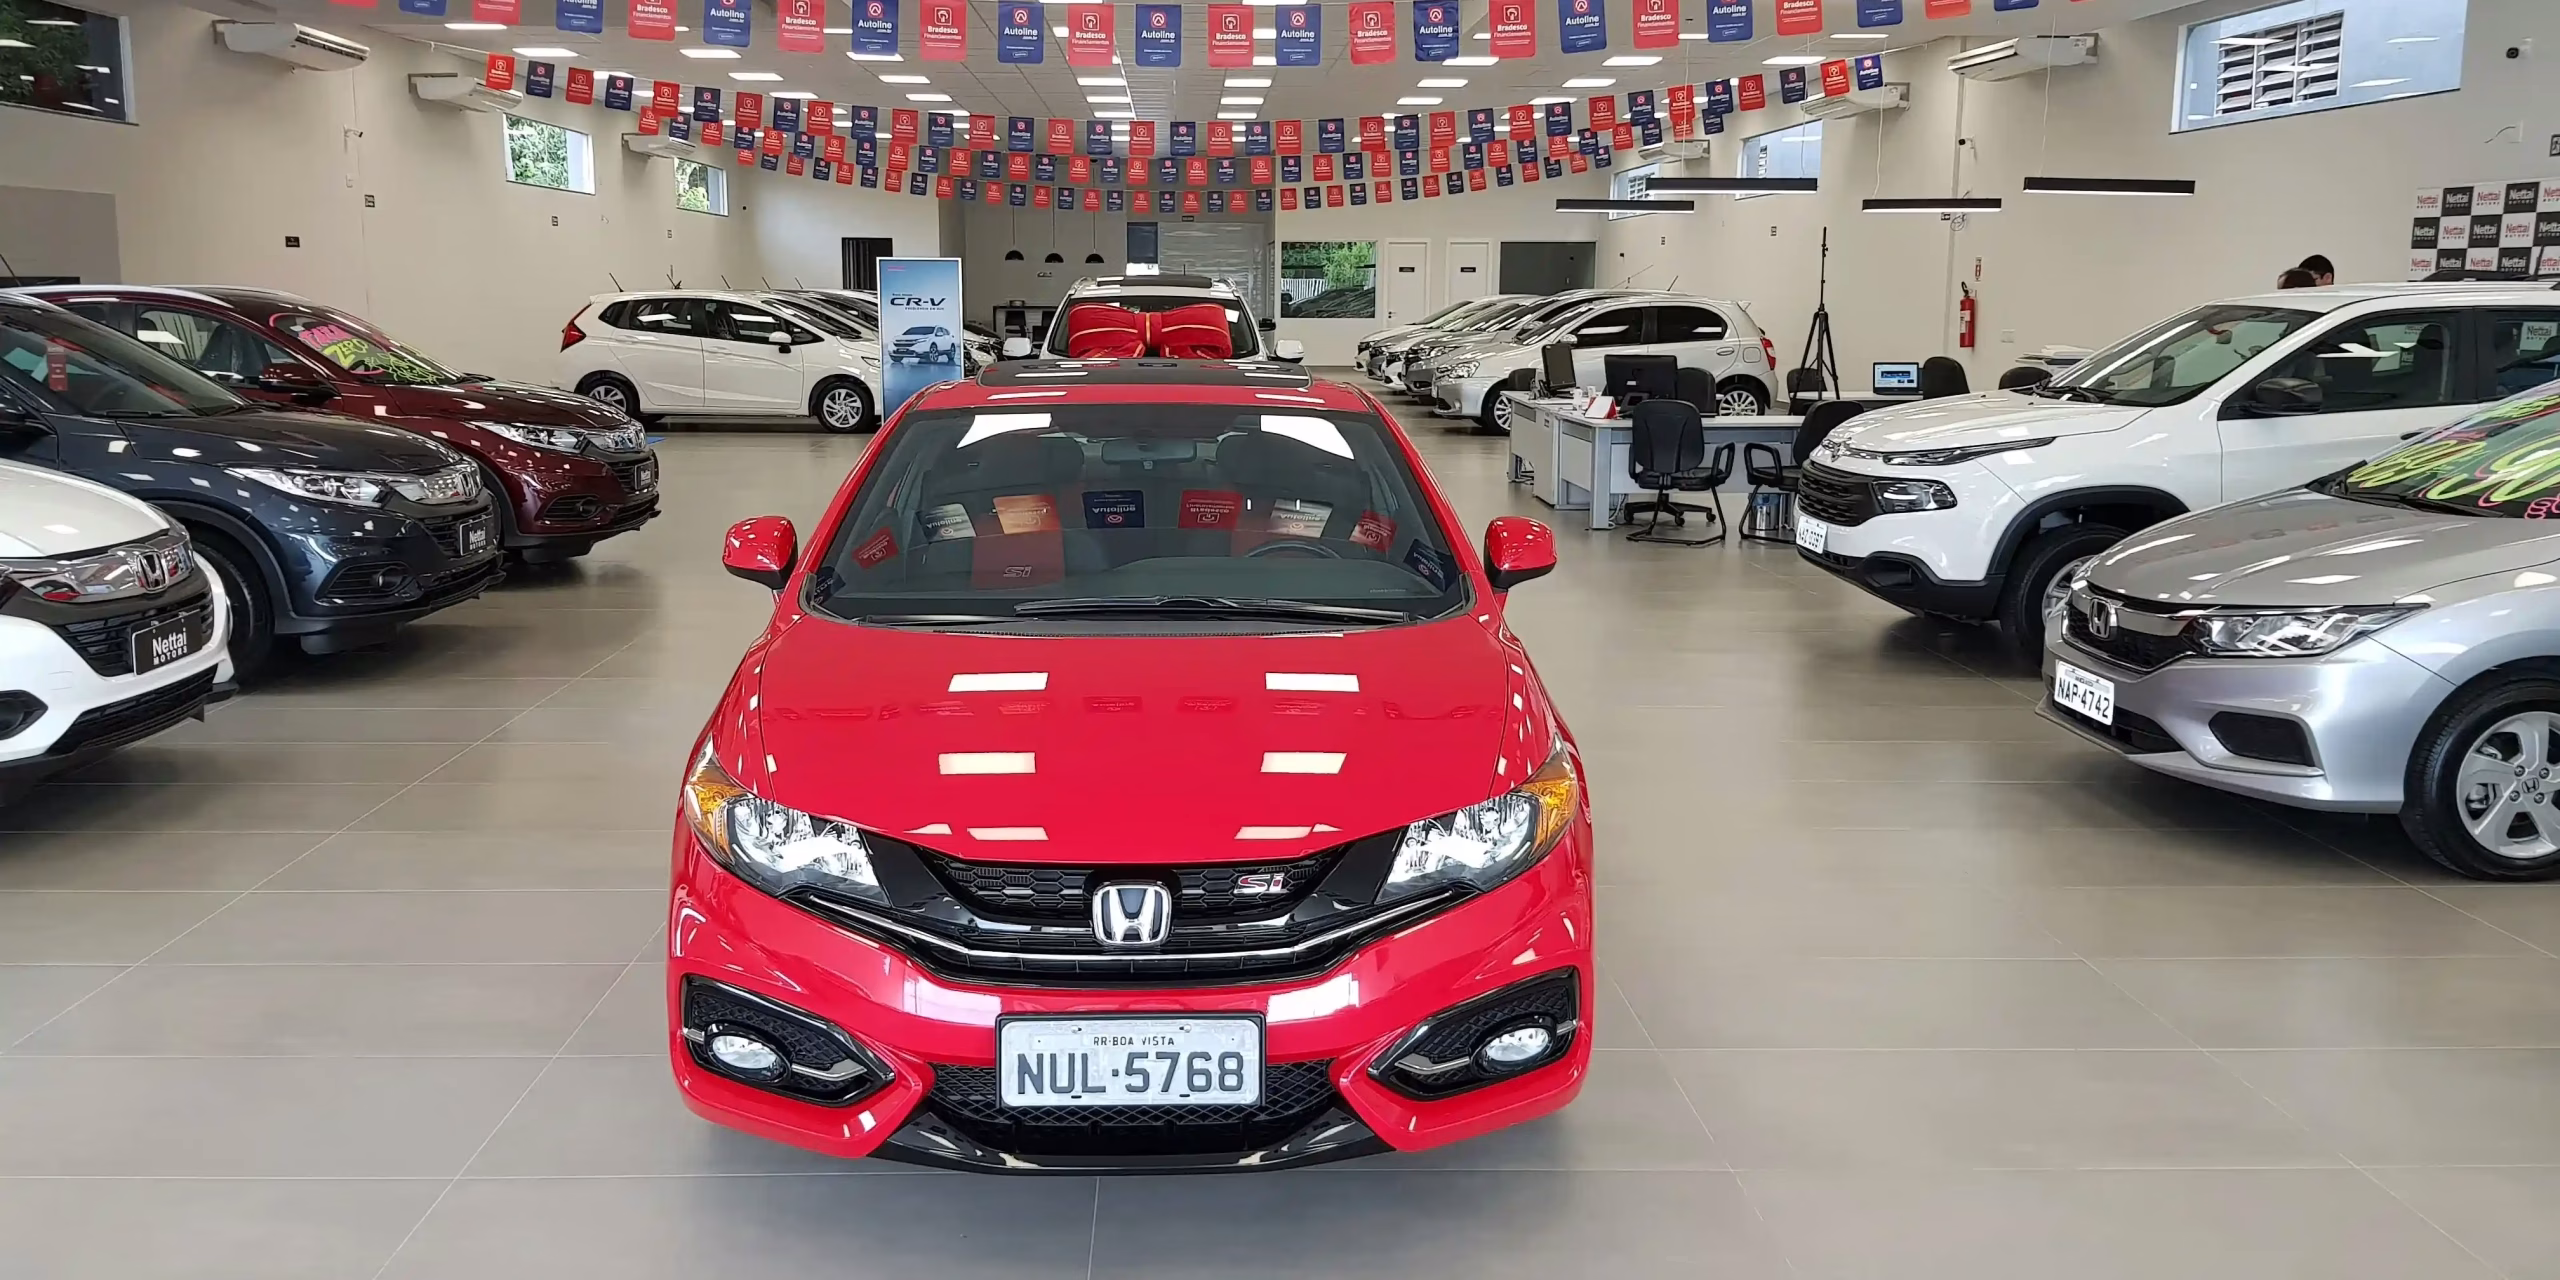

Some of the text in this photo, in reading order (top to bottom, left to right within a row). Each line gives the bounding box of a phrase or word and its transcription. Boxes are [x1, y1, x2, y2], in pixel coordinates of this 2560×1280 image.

[637, 4, 668, 14] Bradesco
[710, 9, 744, 19] Autoline
[1713, 5, 1746, 14] Autoline
[786, 16, 816, 26] Bradesco
[858, 20, 892, 29] Autoline
[1566, 15, 1599, 26] Autoline
[927, 26, 958, 34] Bradesco
[1004, 27, 1038, 36] Autoline
[1142, 30, 1175, 39] Autoline
[1281, 30, 1314, 39] Autoline
[1358, 29, 1387, 38] Bradesco
[1420, 25, 1452, 34] Autoline
[2446, 192, 2470, 204] Nettai
[2477, 190, 2501, 202] Nettai
[2509, 188, 2535, 200] Nettai
[2543, 187, 2560, 199] Nett
[2417, 195, 2439, 205] Nettai
[2414, 226, 2436, 236] Nettai
[2442, 225, 2466, 236] Nettai
[2473, 224, 2498, 235] Nettai
[2506, 222, 2530, 234] Nettai
[2539, 222, 2560, 232] Netta
[2411, 258, 2432, 268] Nettai
[2440, 258, 2462, 268] Nettai
[2470, 256, 2494, 268] Nettai
[2501, 256, 2526, 268] Nettai
[890, 298, 946, 306] CR-V
[321, 338, 368, 369] ZERO
[470, 527, 486, 545] Nettai
[152, 627, 187, 657] Nettai
[153, 645, 188, 666] MOTORS
[1233, 873, 1289, 893] Si
[1141, 1036, 1175, 1048] VISTA
